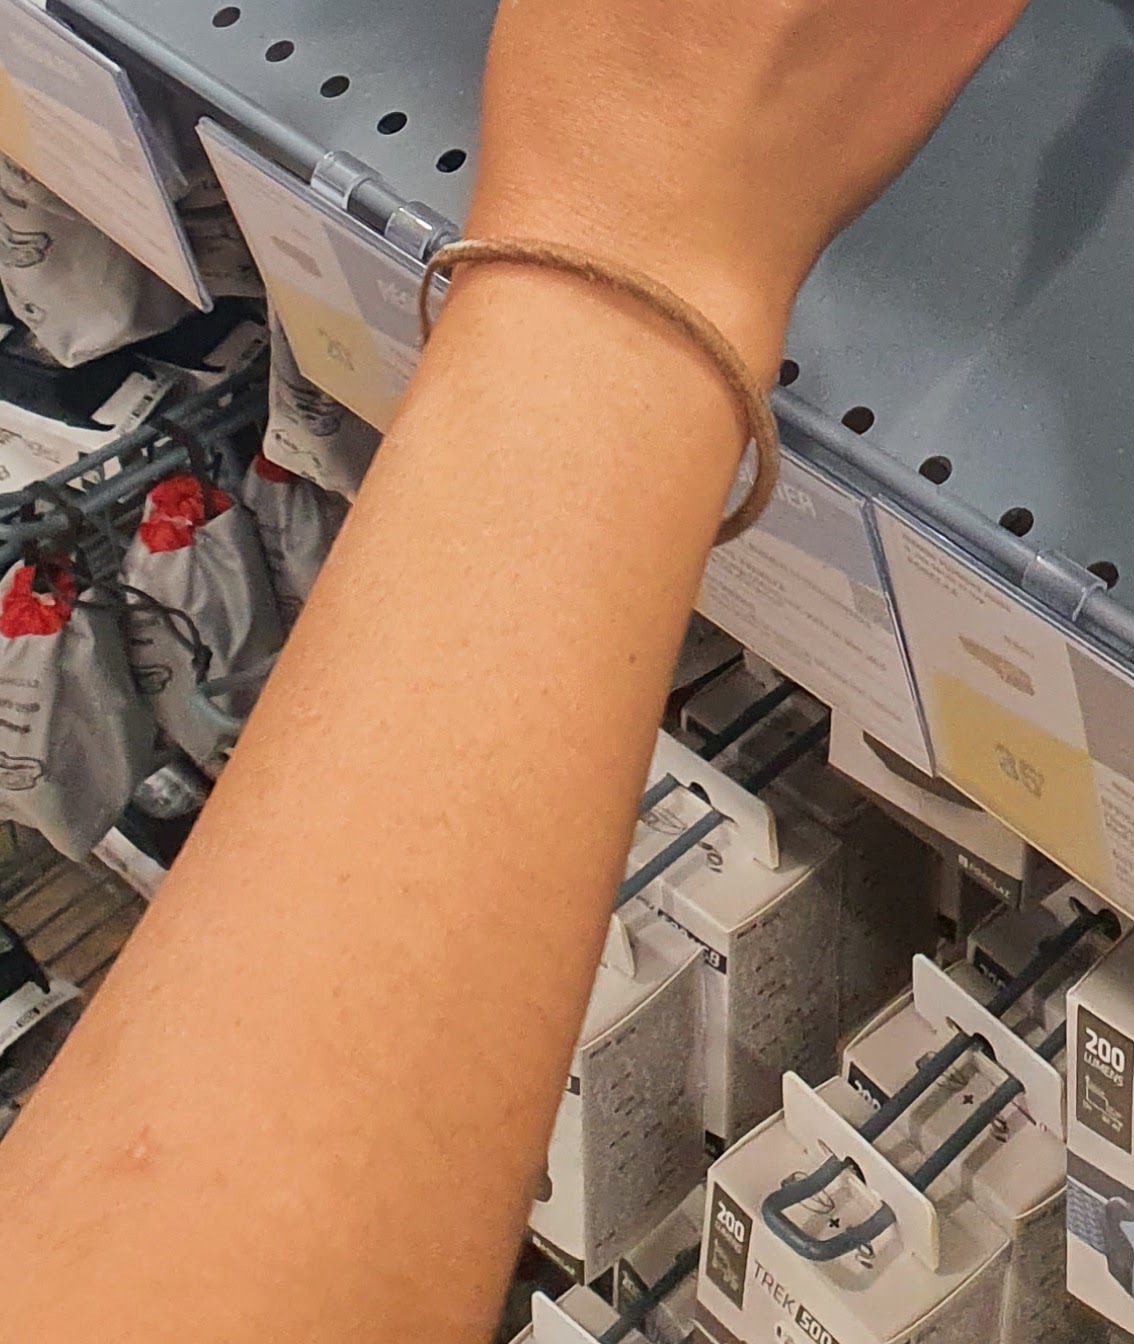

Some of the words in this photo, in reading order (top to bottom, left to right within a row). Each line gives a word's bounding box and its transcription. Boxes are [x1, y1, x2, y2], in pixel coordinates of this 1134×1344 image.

[1083, 1052, 1125, 1088] LUMENS
[1085, 1028, 1126, 1074] 200
[717, 1200, 746, 1244] 200
[753, 1258, 796, 1316] TREK
